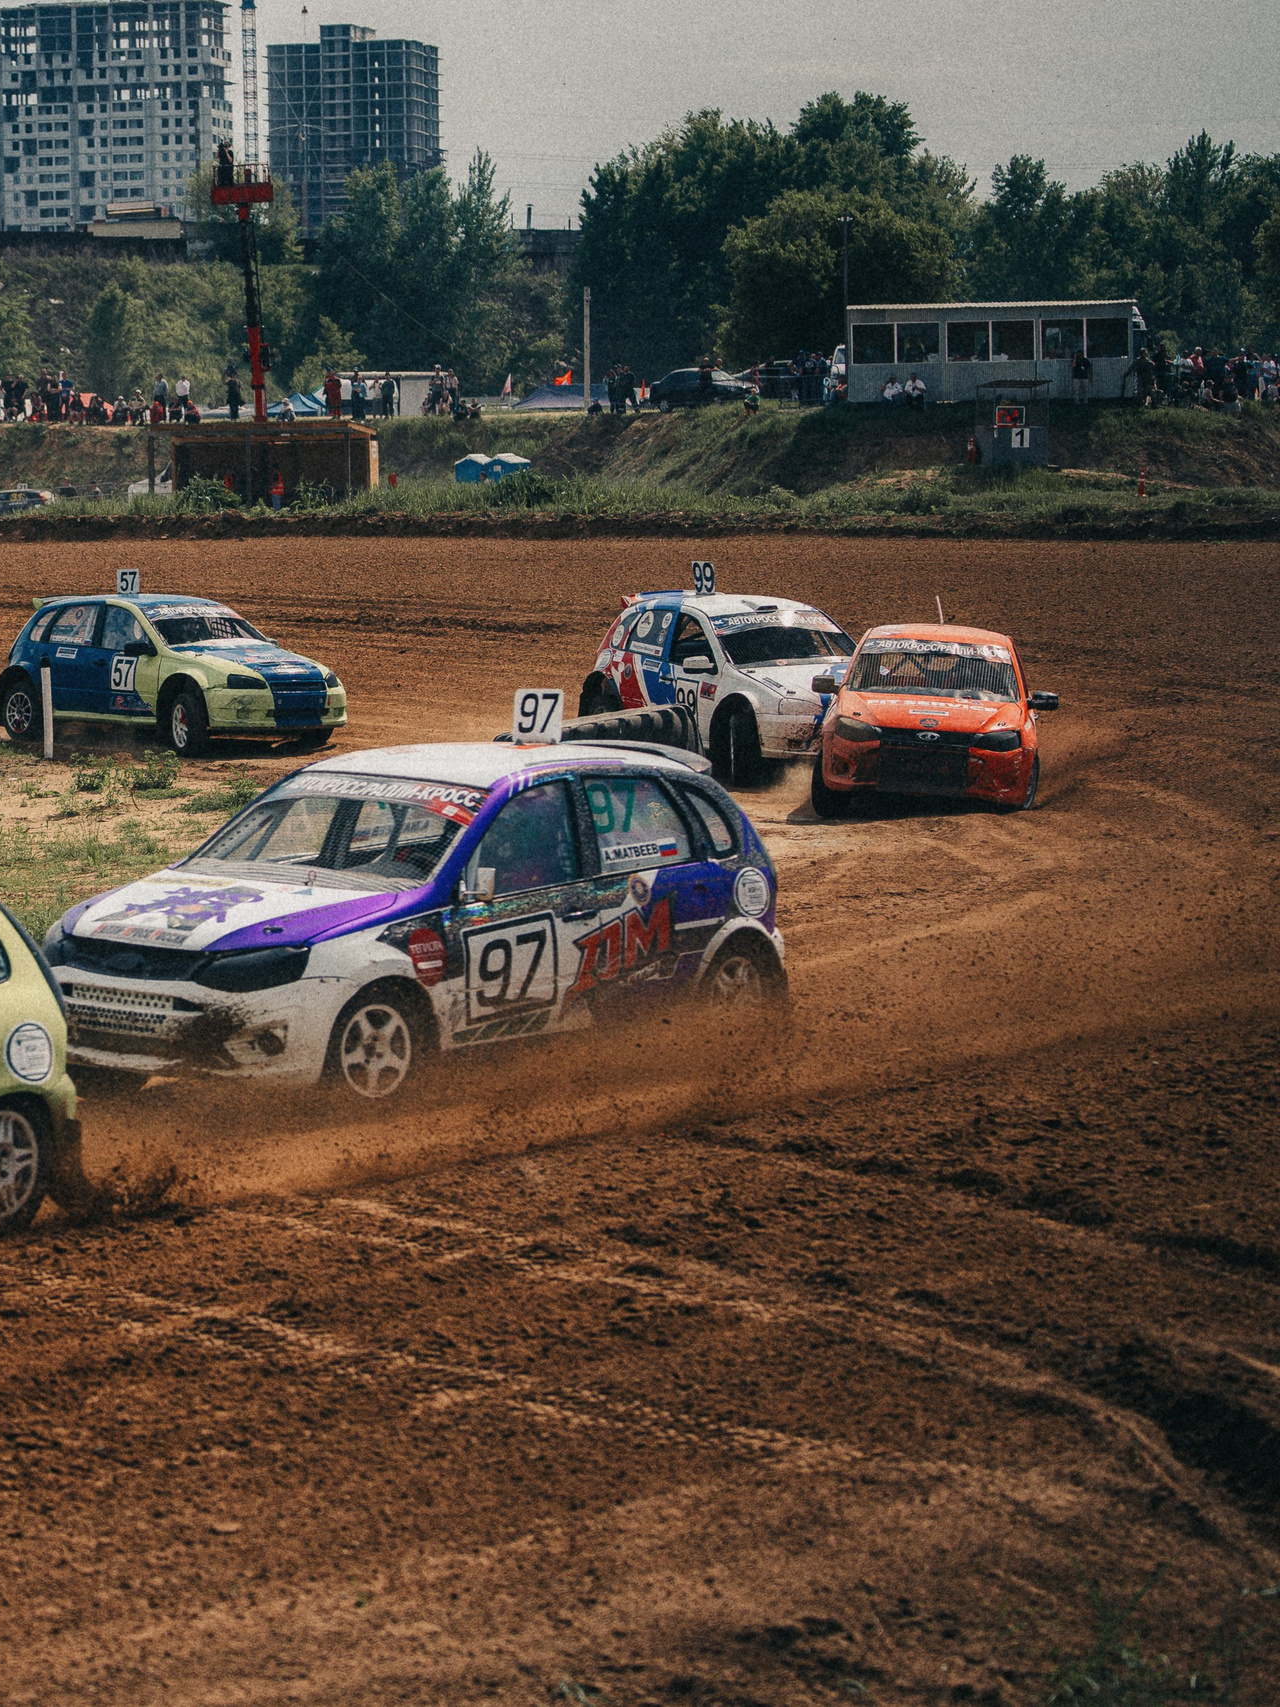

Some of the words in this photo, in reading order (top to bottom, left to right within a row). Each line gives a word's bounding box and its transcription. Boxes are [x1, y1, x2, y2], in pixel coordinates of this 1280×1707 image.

[1015, 428, 1024, 447] 1
[120, 571, 137, 591] 57
[693, 562, 715, 592] 99
[112, 658, 135, 688] 57
[518, 693, 559, 733] 97
[587, 782, 635, 834] 97
[476, 928, 547, 1008] 97
